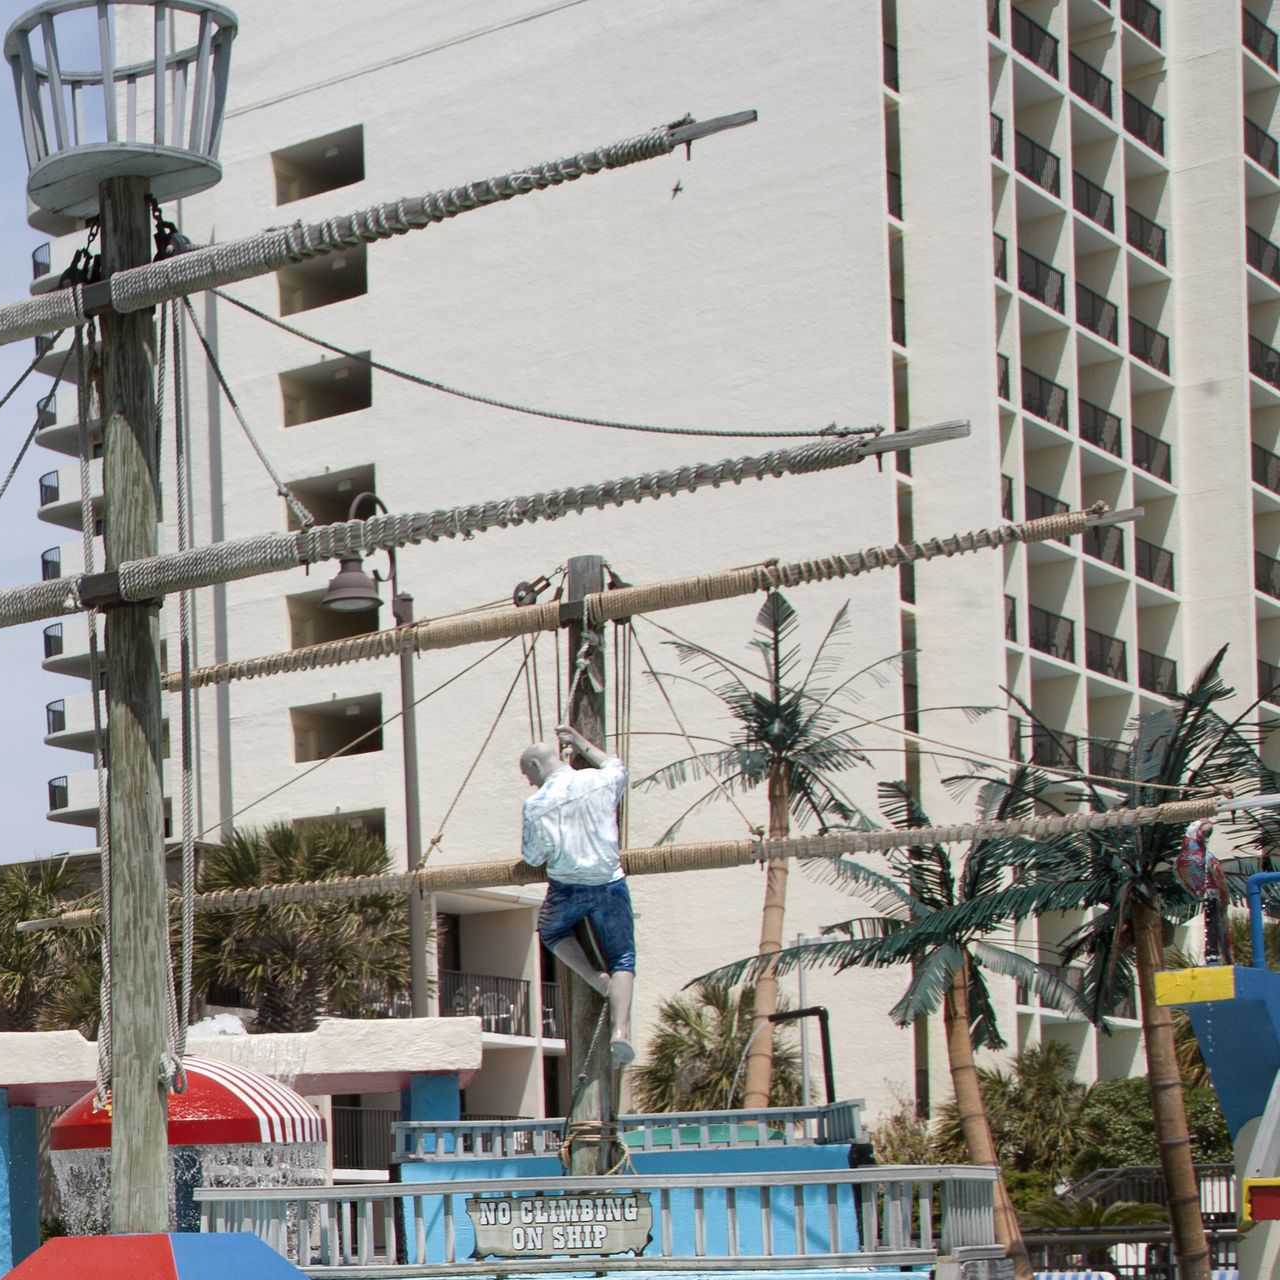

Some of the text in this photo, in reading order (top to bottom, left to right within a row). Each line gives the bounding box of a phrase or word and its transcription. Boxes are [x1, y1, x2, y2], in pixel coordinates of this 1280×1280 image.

[479, 1197, 639, 1225] NO CLIMBING
[511, 1224, 608, 1250] ON SHIP
